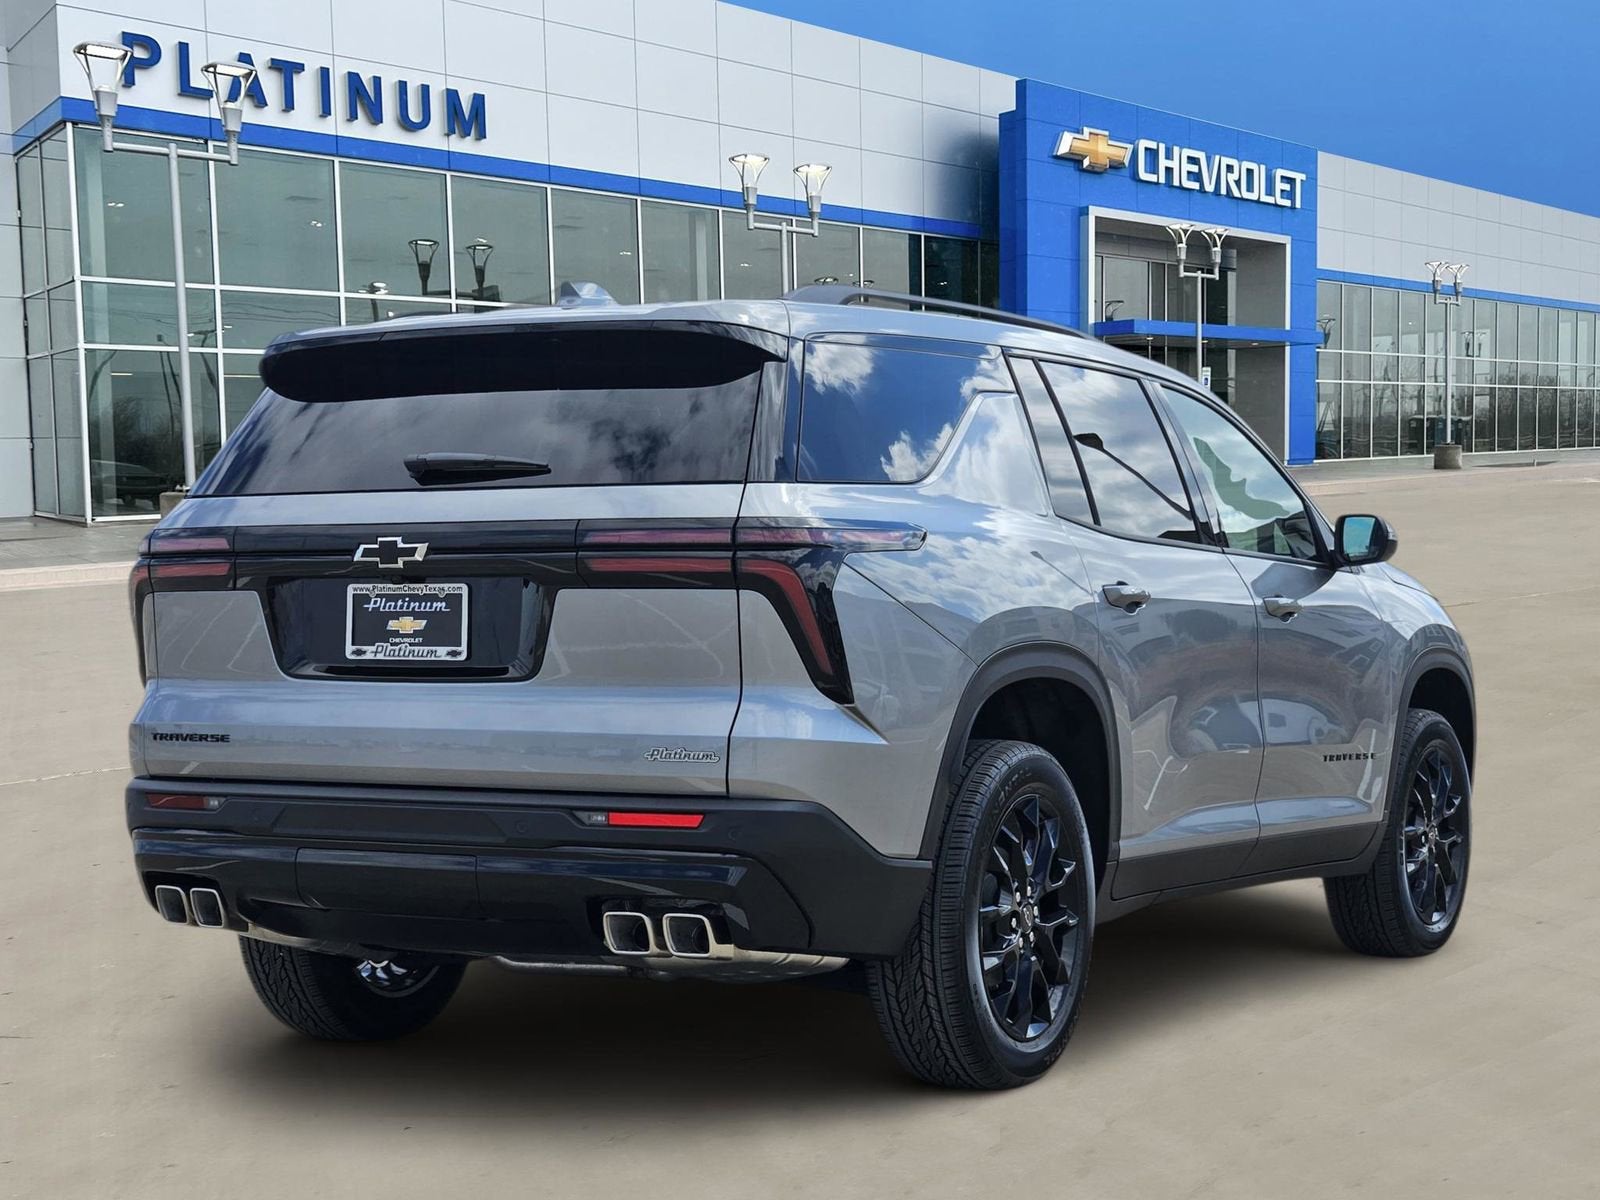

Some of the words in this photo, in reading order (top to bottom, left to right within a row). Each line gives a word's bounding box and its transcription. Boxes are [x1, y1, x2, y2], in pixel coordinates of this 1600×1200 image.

[121, 31, 487, 140] PLATINUM
[1136, 138, 1307, 209] CHEVROLET
[352, 584, 463, 595] www.PlatinumChevyTexas.com
[363, 597, 451, 612] Platinum
[371, 644, 442, 658] Platinum
[151, 732, 231, 743] TRAVERSE
[643, 747, 720, 763] Platinum
[1322, 752, 1377, 762] TRAVERSE
